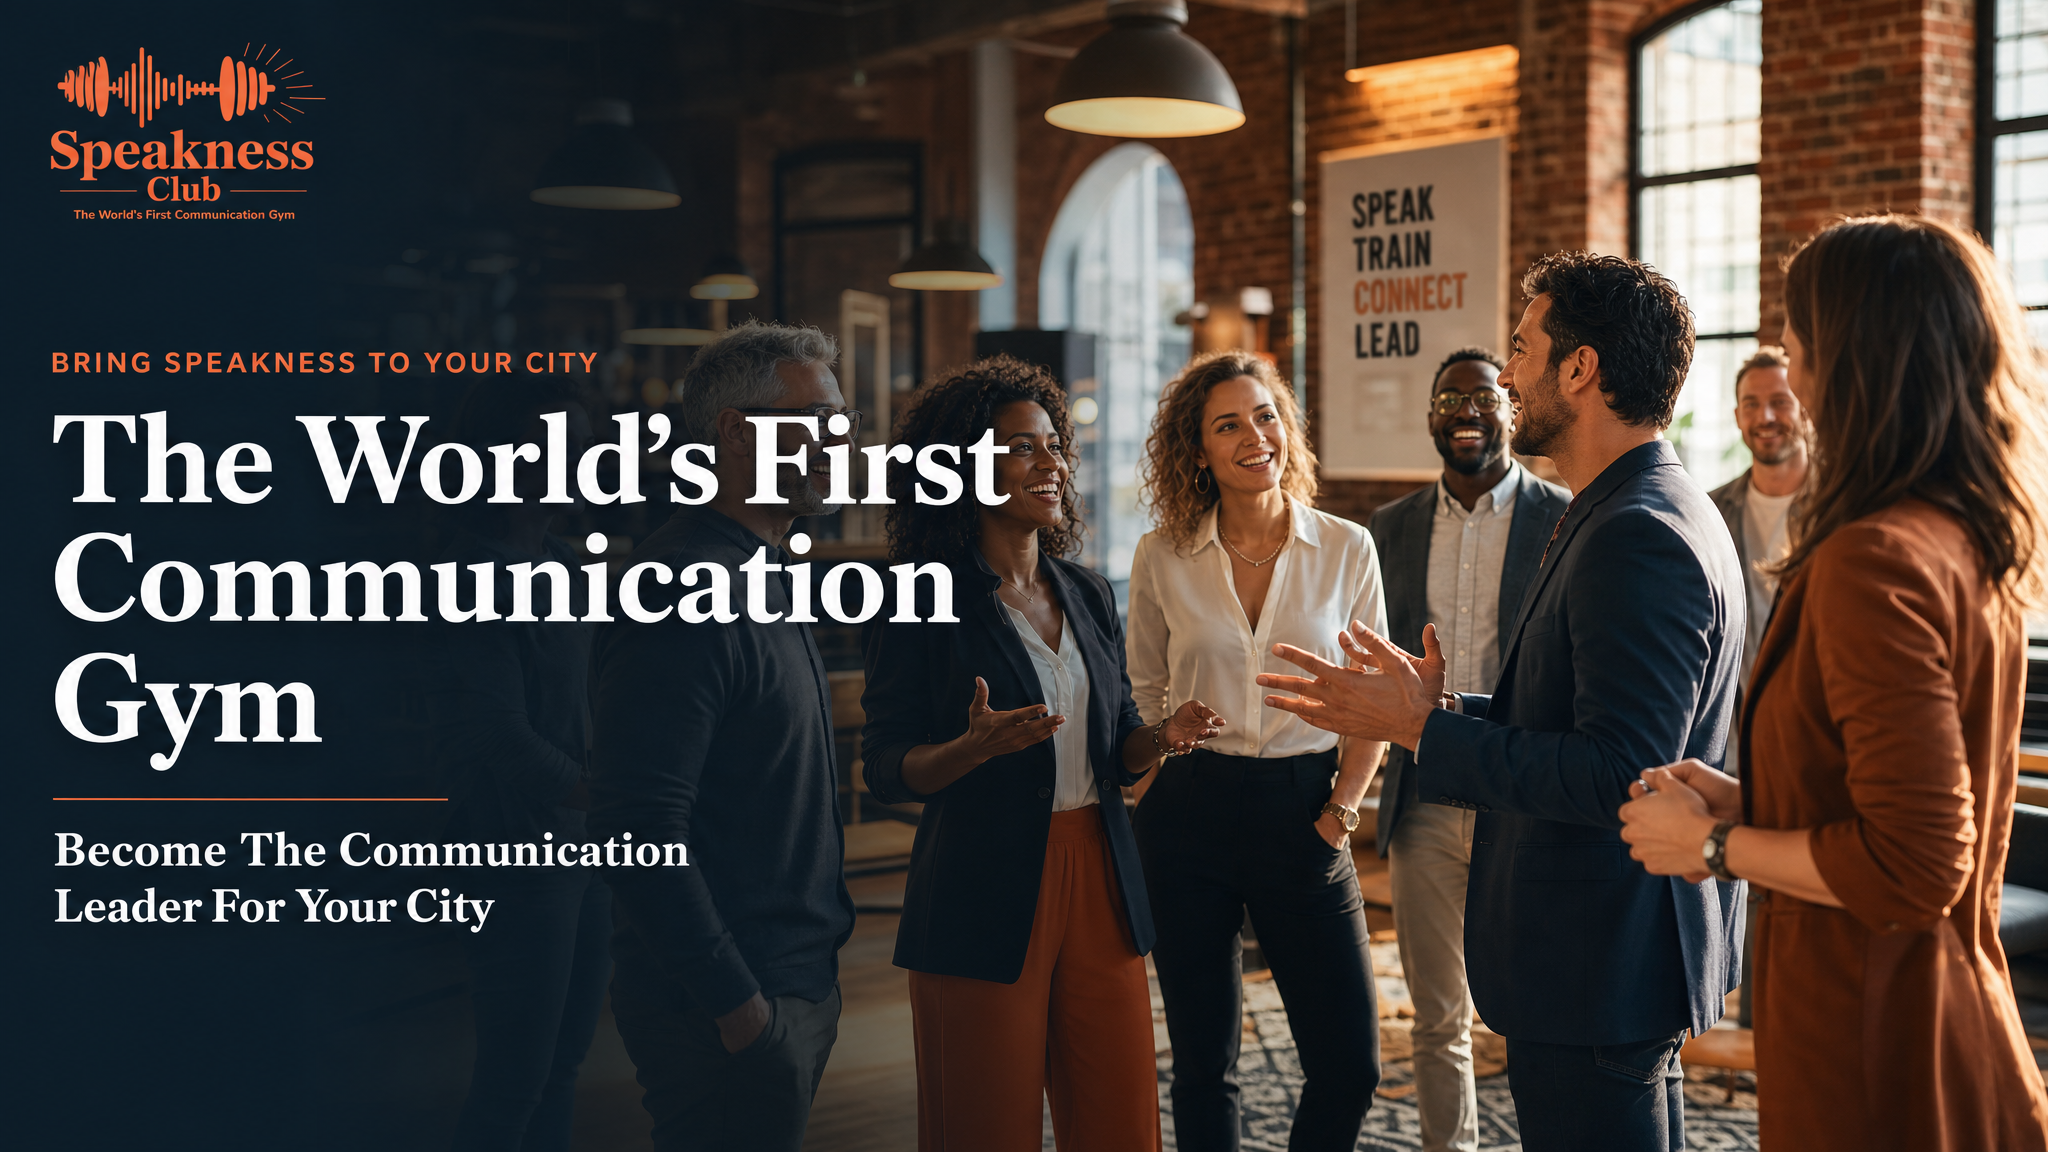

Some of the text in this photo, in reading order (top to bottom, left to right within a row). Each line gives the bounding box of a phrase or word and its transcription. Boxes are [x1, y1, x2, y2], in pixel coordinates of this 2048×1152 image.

[1352, 185, 1435, 229] SPEAK
[1353, 230, 1431, 272] TRAIN
[1354, 272, 1468, 316] CONNECT
[1355, 320, 1420, 359] LEAD
